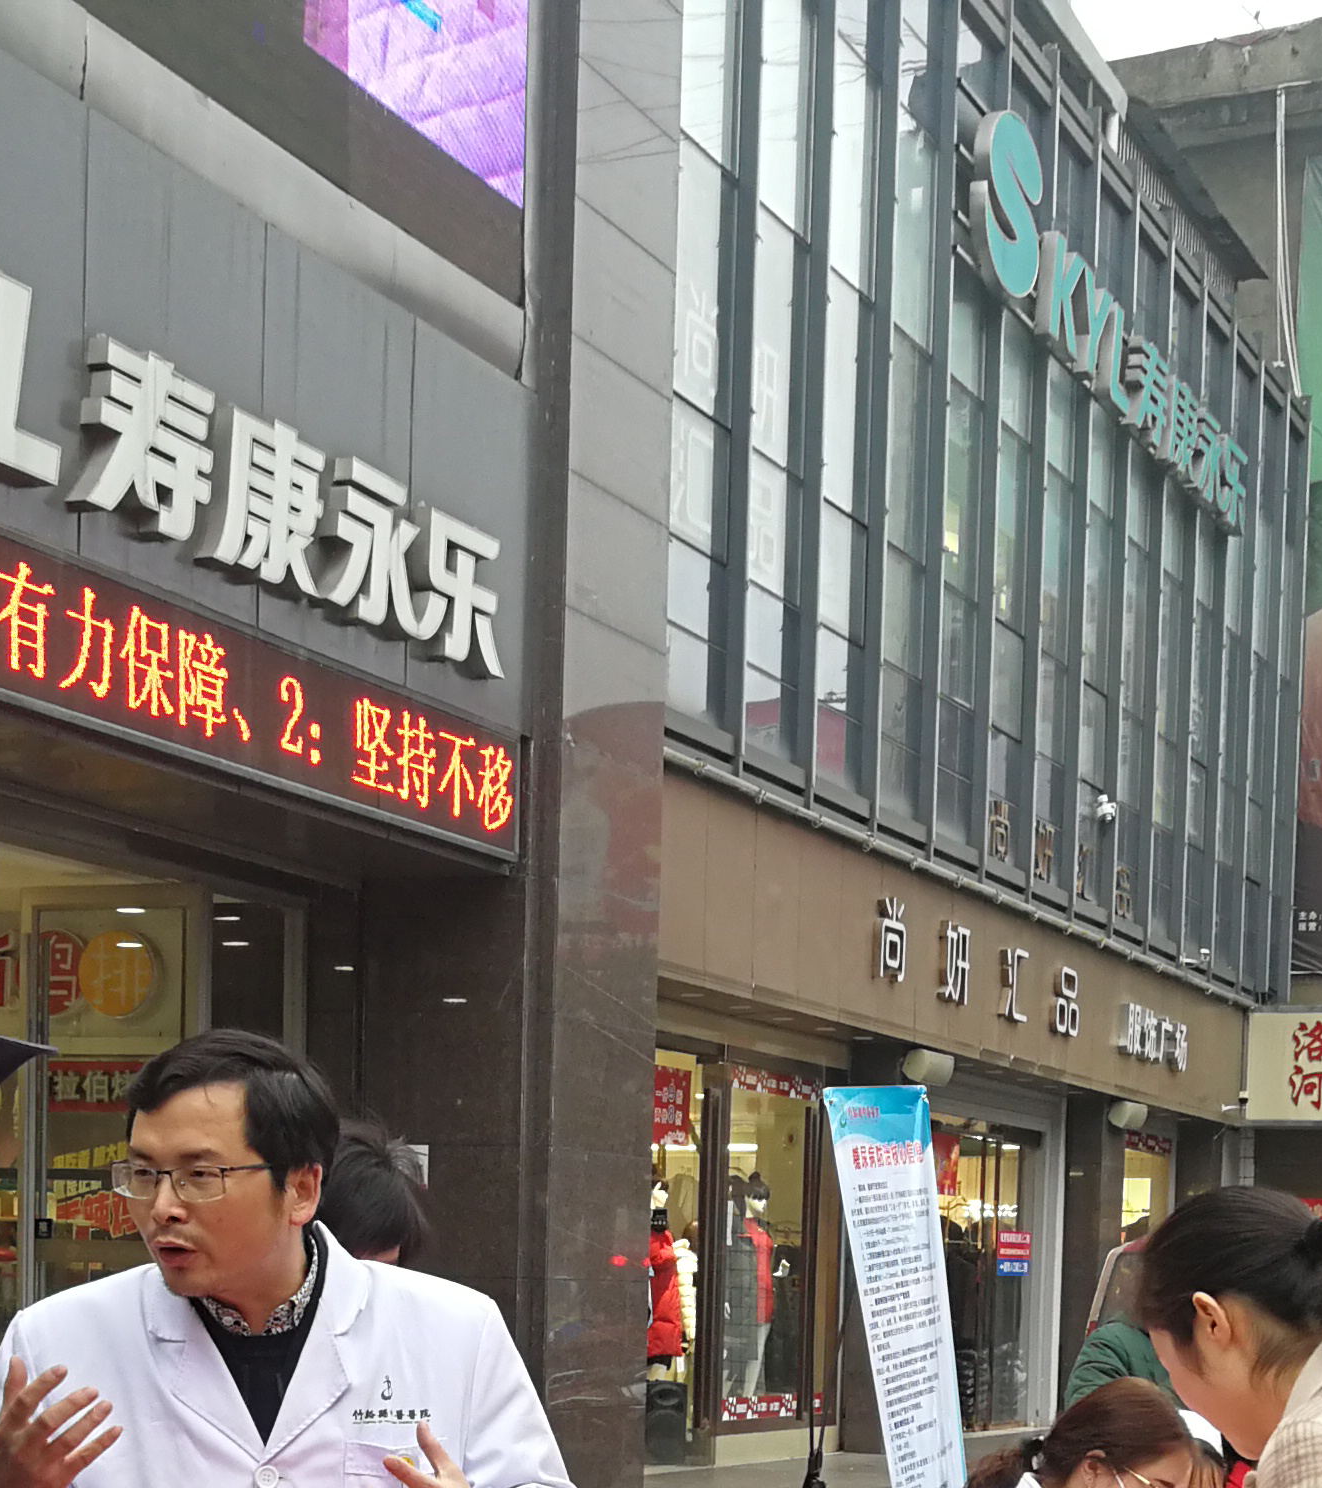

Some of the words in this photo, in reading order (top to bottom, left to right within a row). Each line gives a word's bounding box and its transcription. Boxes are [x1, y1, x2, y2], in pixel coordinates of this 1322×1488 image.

[972, 109, 1129, 420] SKYL
[1125, 334, 1248, 537] 寿康永乐
[70, 335, 505, 680] 寿康永乐
[879, 896, 1081, 1038] 尚妍汇品
